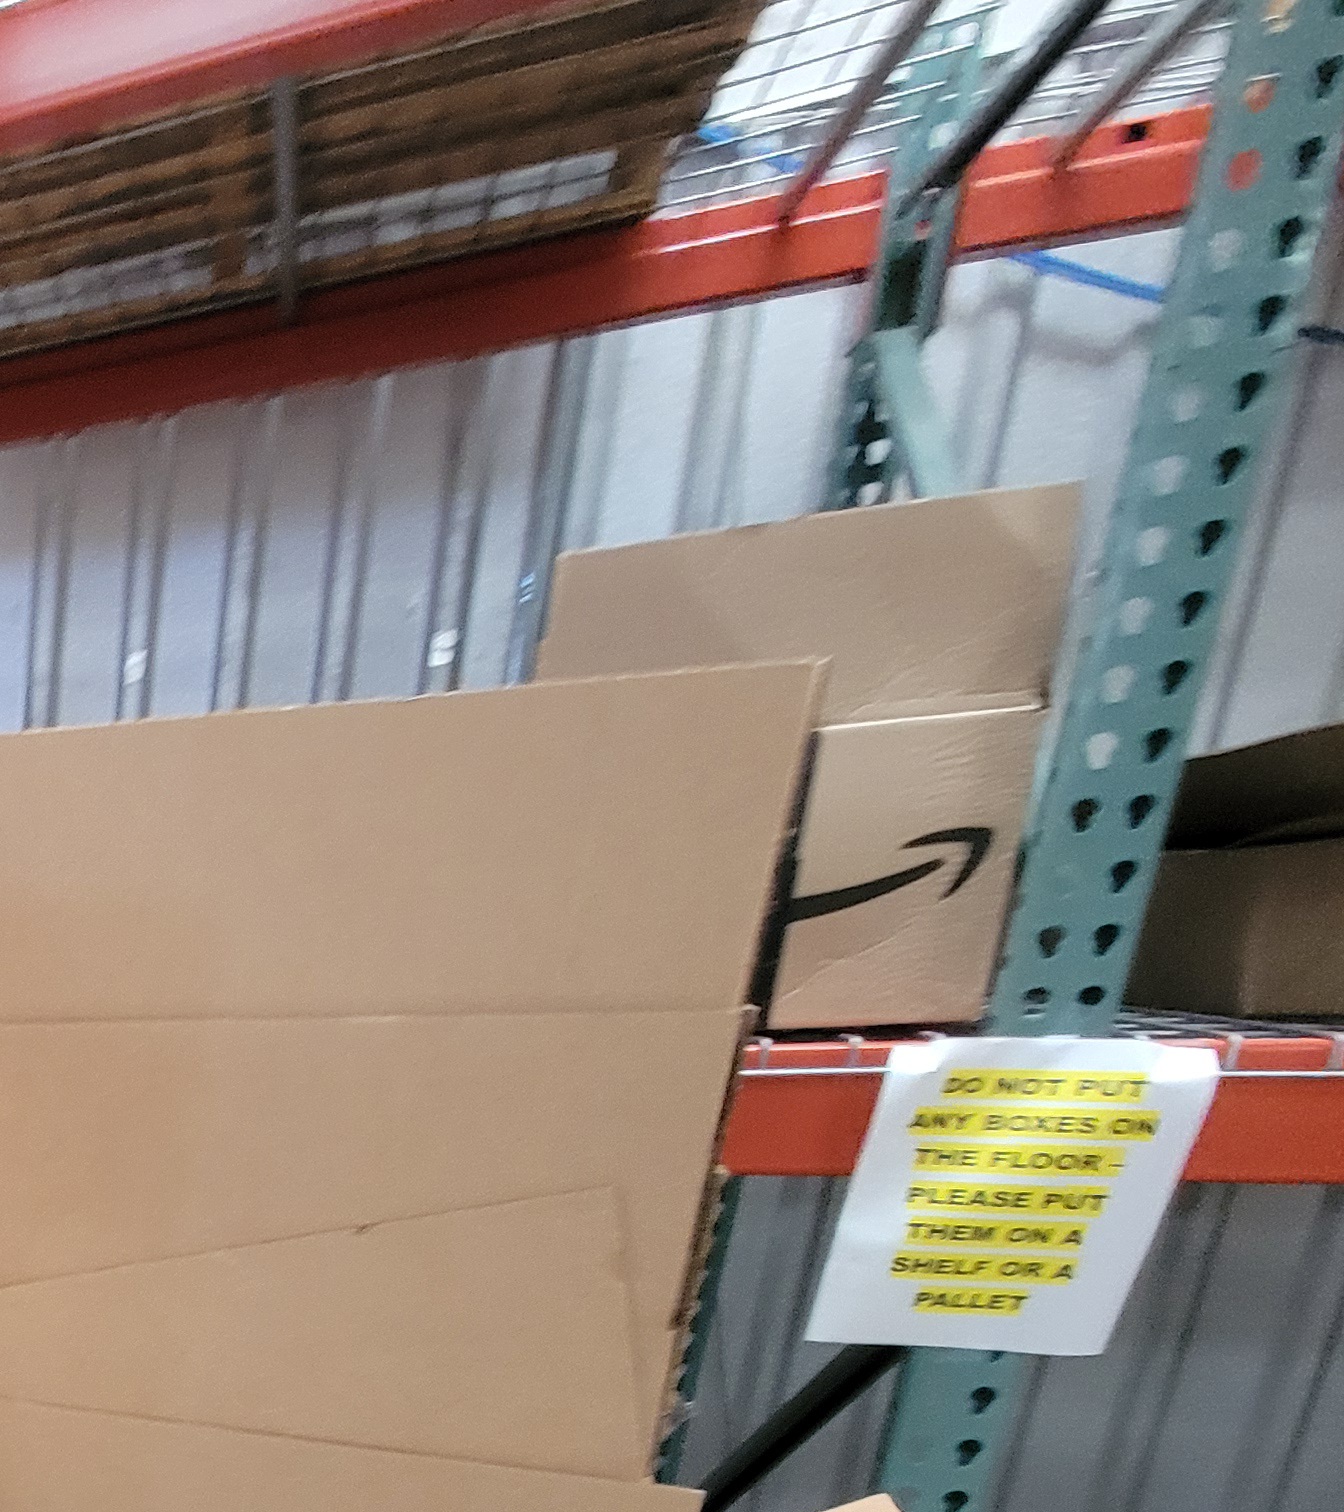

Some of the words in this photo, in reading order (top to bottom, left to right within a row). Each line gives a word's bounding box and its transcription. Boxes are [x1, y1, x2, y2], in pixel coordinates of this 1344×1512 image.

[942, 1076, 983, 1094] DO
[992, 1077, 1066, 1097] NOT
[1074, 1079, 1151, 1098] PUT
[908, 1112, 973, 1131] ANY
[982, 1114, 1099, 1134] BOXES
[1108, 1117, 1157, 1137] ON
[915, 1147, 978, 1167] THE
[988, 1151, 1102, 1172] FLOOR
[906, 1186, 1032, 1208] PLEASE
[1040, 1193, 1109, 1212] PUT
[907, 1222, 997, 1242] THEM
[1006, 1227, 1058, 1245] ON
[1062, 1230, 1084, 1246] A
[890, 1256, 992, 1276] SHELF
[999, 1261, 1045, 1278] OR
[1050, 1264, 1074, 1280] A
[914, 1291, 1029, 1311] PALLET
